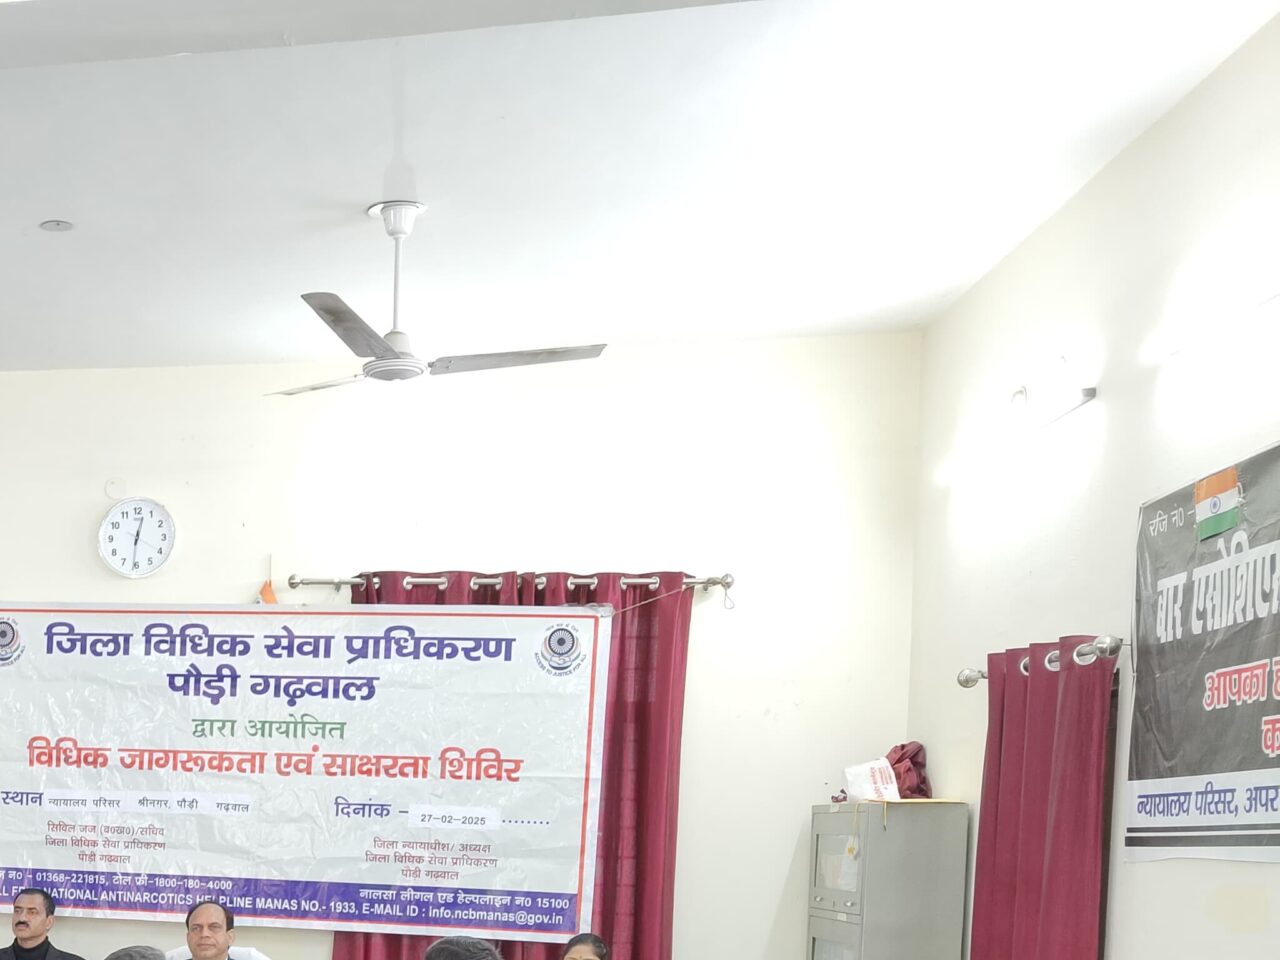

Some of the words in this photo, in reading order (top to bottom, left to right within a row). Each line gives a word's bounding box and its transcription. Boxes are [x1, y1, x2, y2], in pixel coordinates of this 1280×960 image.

[121, 511, 129, 519] 11
[134, 507, 142, 515] 12
[149, 510, 153, 518] 1
[111, 522, 120, 530] 10
[158, 520, 163, 528] 2
[1149, 510, 1168, 536] रजि
[108, 535, 114, 543] 9
[161, 533, 167, 541] 3
[112, 548, 117, 556] 8
[157, 547, 163, 555] 4
[121, 558, 126, 566] 7
[148, 557, 153, 565] 5
[1156, 571, 1187, 644] बार
[44, 622, 134, 657] जिला
[142, 623, 254, 658] विधिक
[264, 625, 335, 659] सेवा
[345, 625, 516, 664] प्राधिकरण
[166, 663, 240, 705] पौड़ी
[250, 674, 380, 706] गढ़वाल
[1203, 658, 1270, 711] आपका
[191, 718, 237, 738] द्वारा
[245, 713, 347, 740] आयोजित
[27, 735, 111, 768] विधिक
[117, 748, 267, 774] जागरूकता
[274, 744, 320, 777] एवं
[322, 753, 431, 779] साक्षरता
[439, 746, 524, 782] शिविर
[1, 790, 43, 806] स्थान
[48, 798, 87, 808] न्यायालय
[92, 797, 121, 808] परिसर
[177, 798, 198, 810] पौड़ी
[1137, 792, 1192, 818] न्यायालय
[1195, 781, 1238, 818] परिसर,
[334, 796, 392, 818] दिनांक
[421, 814, 486, 825] 27-02-2025
[47, 820, 75, 833] सिविल
[79, 824, 96, 833] जज
[45, 835, 67, 847] जिला
[71, 835, 99, 848] विधिक
[102, 837, 120, 849] सेवा
[123, 838, 166, 850] प्राधिकरण
[373, 837, 398, 849] जिला
[458, 842, 491, 854] अध्यक्ष
[365, 850, 390, 863] जिला
[394, 851, 425, 864] विधिक
[427, 853, 447, 865] सेवा
[451, 854, 498, 868] प्राधिकरण
[36, 871, 109, 886] 01368-221815,
[112, 872, 132, 887] टोल
[359, 889, 397, 900] नालसा
[400, 888, 434, 902] लीगल
[438, 892, 454, 904] एड
[457, 890, 512, 907] हेल्पलाइन
[536, 898, 569, 908] 15100
[100, 889, 192, 905] ANTINARCOTICS
[256, 897, 298, 910] MANAS
[330, 901, 358, 915] 1933,
[362, 903, 403, 916] E-MAIL
[407, 905, 418, 916] ID
[429, 906, 563, 925] info.ncbmanas@gov.in
